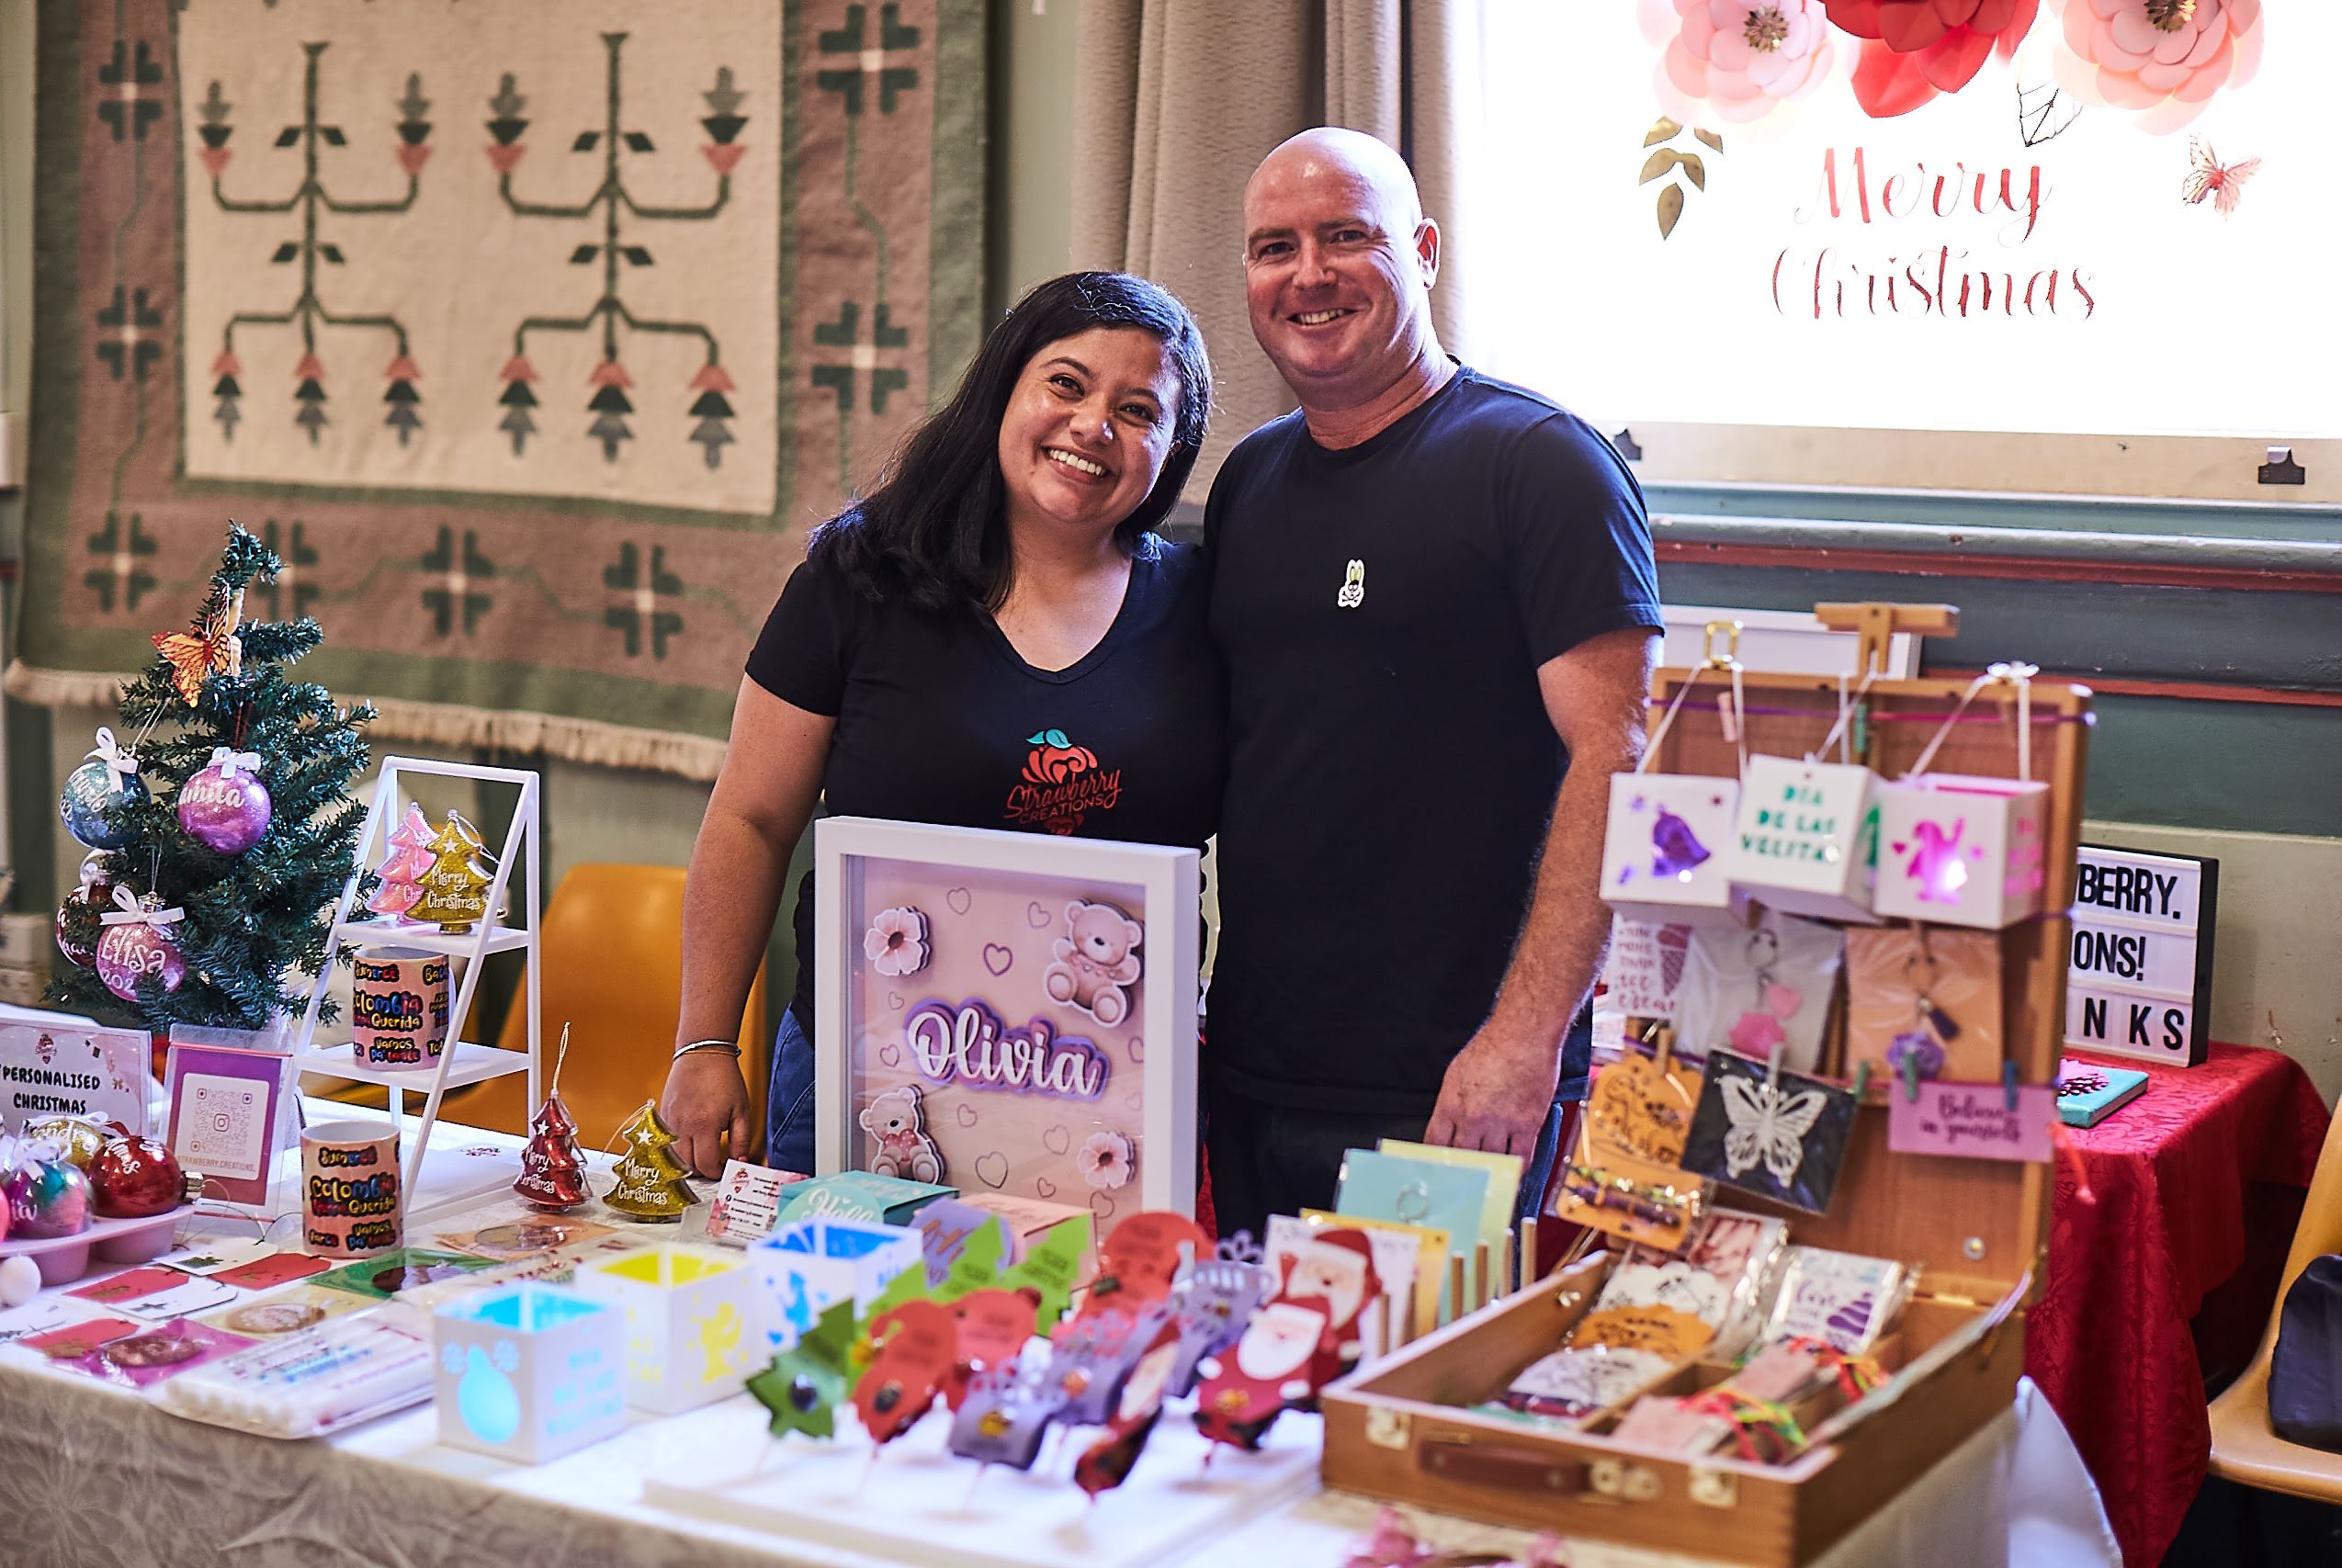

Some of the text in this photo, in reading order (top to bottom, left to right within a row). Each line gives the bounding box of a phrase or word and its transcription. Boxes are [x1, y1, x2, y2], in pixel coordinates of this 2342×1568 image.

[1794, 146, 2053, 248] Merry
[1772, 245, 2097, 320] Christmas
[1003, 768, 1123, 818] Strawberry
[1019, 794, 1103, 824] CREATIONS
[1742, 834, 1838, 863] VELITA
[432, 867, 470, 892] Merry
[2076, 863, 2181, 919] BERRY.
[427, 889, 481, 910] Christmas
[2072, 931, 2147, 981] ONS!
[908, 1008, 1101, 1096] Olivia
[3, 1066, 101, 1090] PERSONALISED
[13, 1092, 86, 1115] CHRISTMAS
[525, 1145, 549, 1173] Merry
[625, 1157, 661, 1187] Merry
[617, 1183, 668, 1205] Christmas
